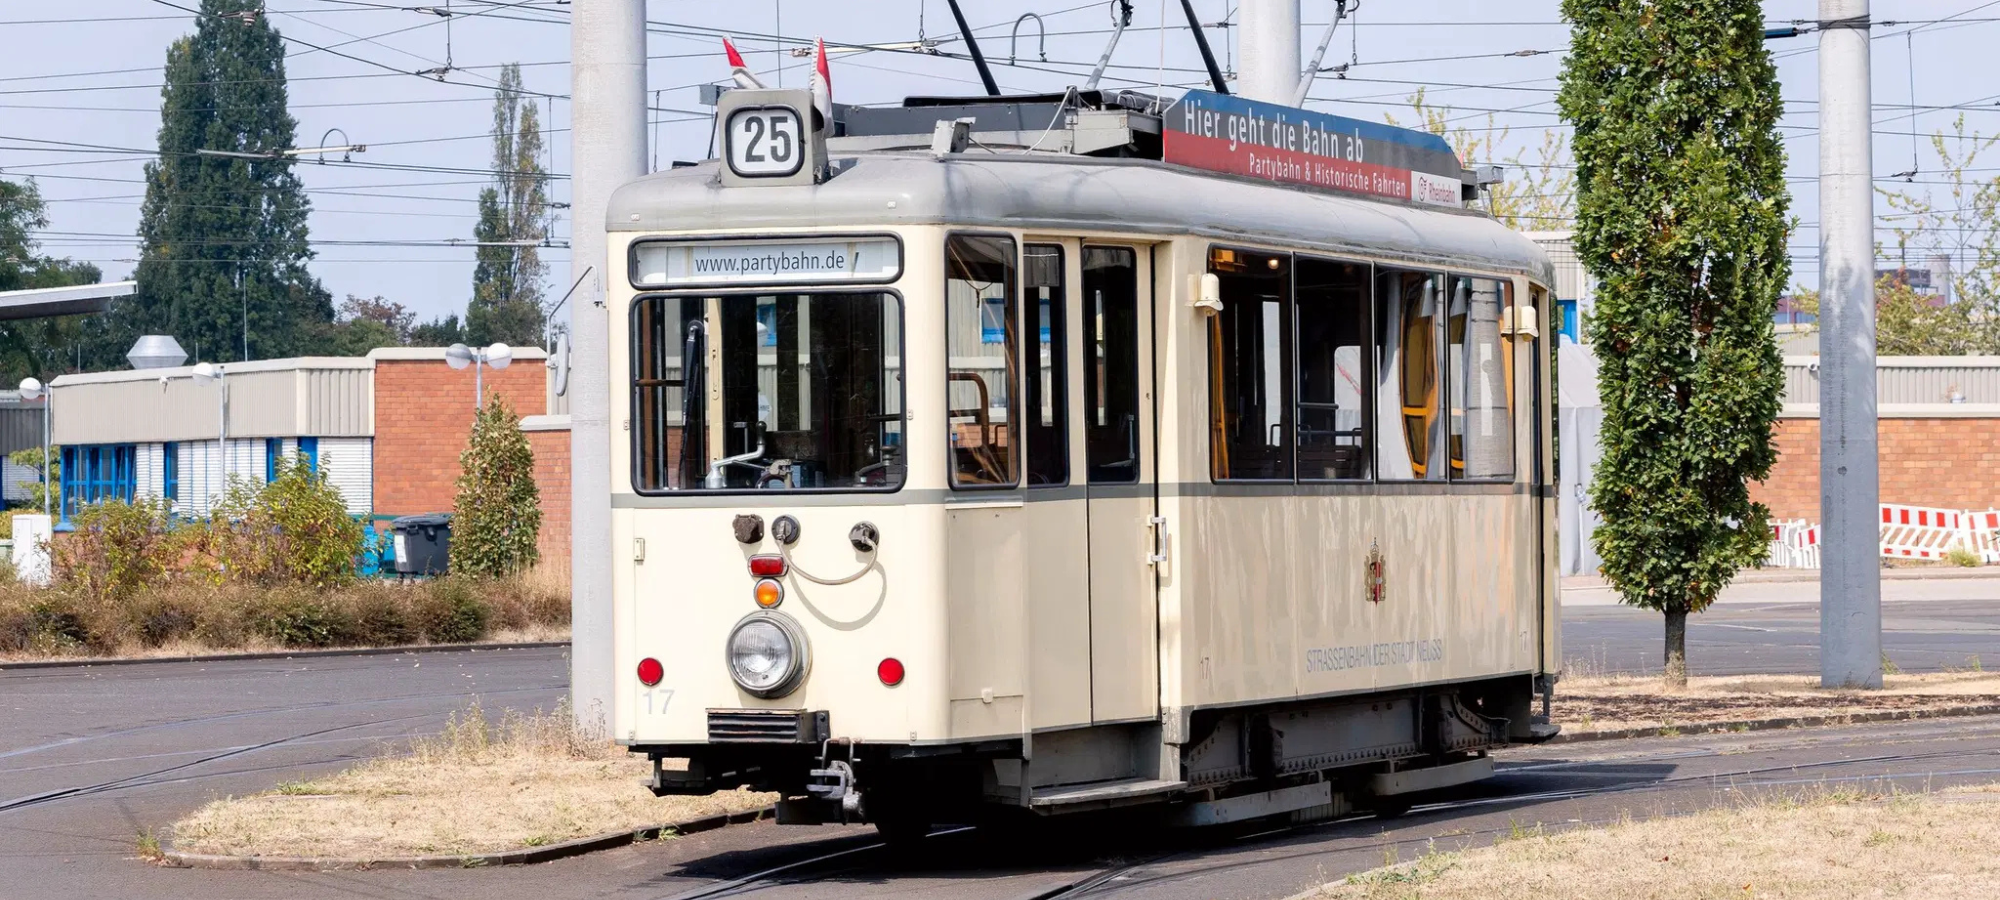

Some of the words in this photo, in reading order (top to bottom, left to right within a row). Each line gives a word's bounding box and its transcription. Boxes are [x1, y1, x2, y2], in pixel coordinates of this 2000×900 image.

[744, 115, 792, 163] 25
[1184, 99, 1220, 139] Hier
[1228, 107, 1266, 152] geht
[1272, 113, 1296, 151] die
[1302, 120, 1339, 159] Bahn
[1346, 128, 1364, 163] ab
[1249, 152, 1301, 181] Partybahn
[1304, 161, 1311, 181] &
[1314, 163, 1369, 191] Historische
[1372, 172, 1406, 197] Fahrten
[695, 250, 844, 275] www.partybahn.de
[1306, 645, 1372, 673] STRASSENBAHN
[1391, 641, 1415, 665] STADT
[1416, 638, 1442, 662] NEUSS
[642, 688, 675, 715] 17
